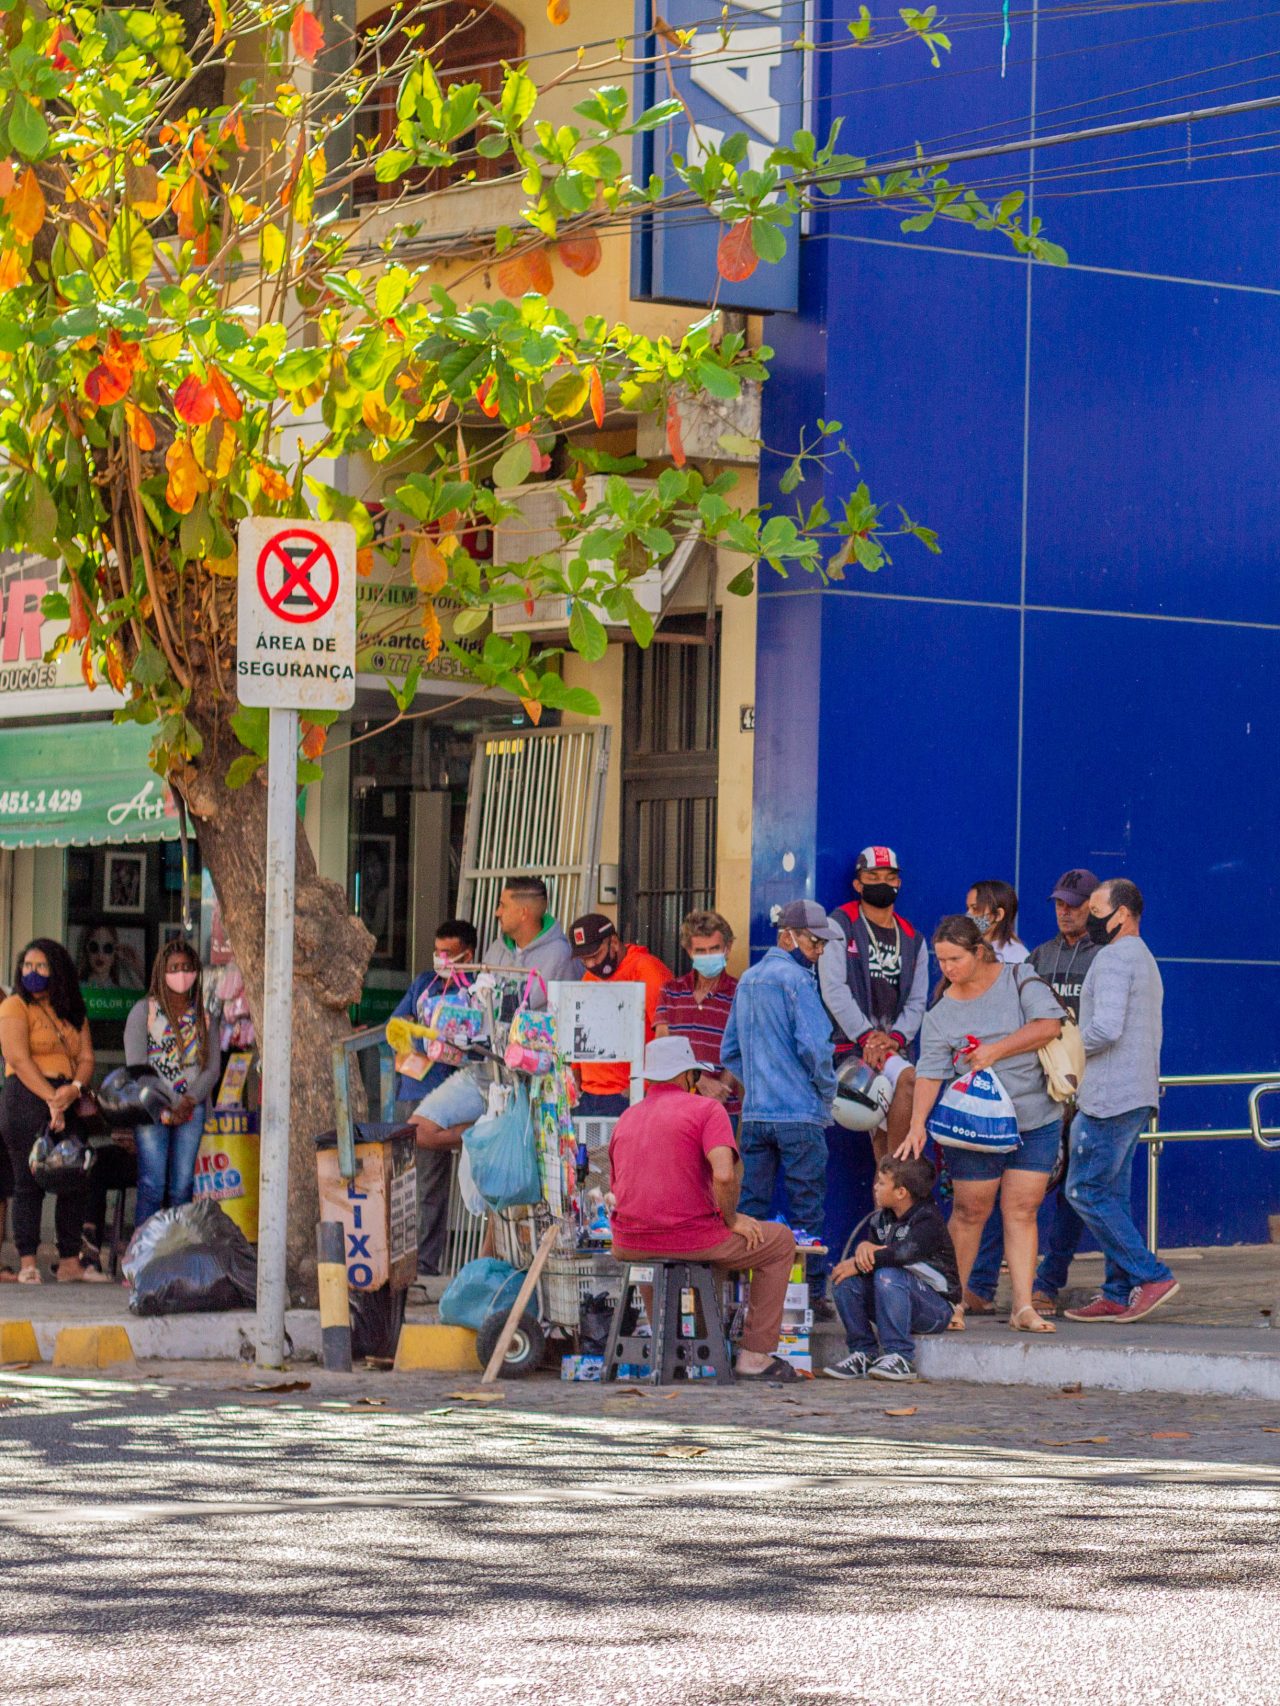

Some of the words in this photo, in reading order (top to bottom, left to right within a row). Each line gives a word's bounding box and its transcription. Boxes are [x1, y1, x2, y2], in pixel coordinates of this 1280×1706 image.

[255, 632, 306, 650] ÁREA
[313, 638, 336, 652] DE
[238, 661, 354, 683] SEGURANÇA
[388, 654, 412, 673] 77
[347, 1179, 373, 1288] LIXO
